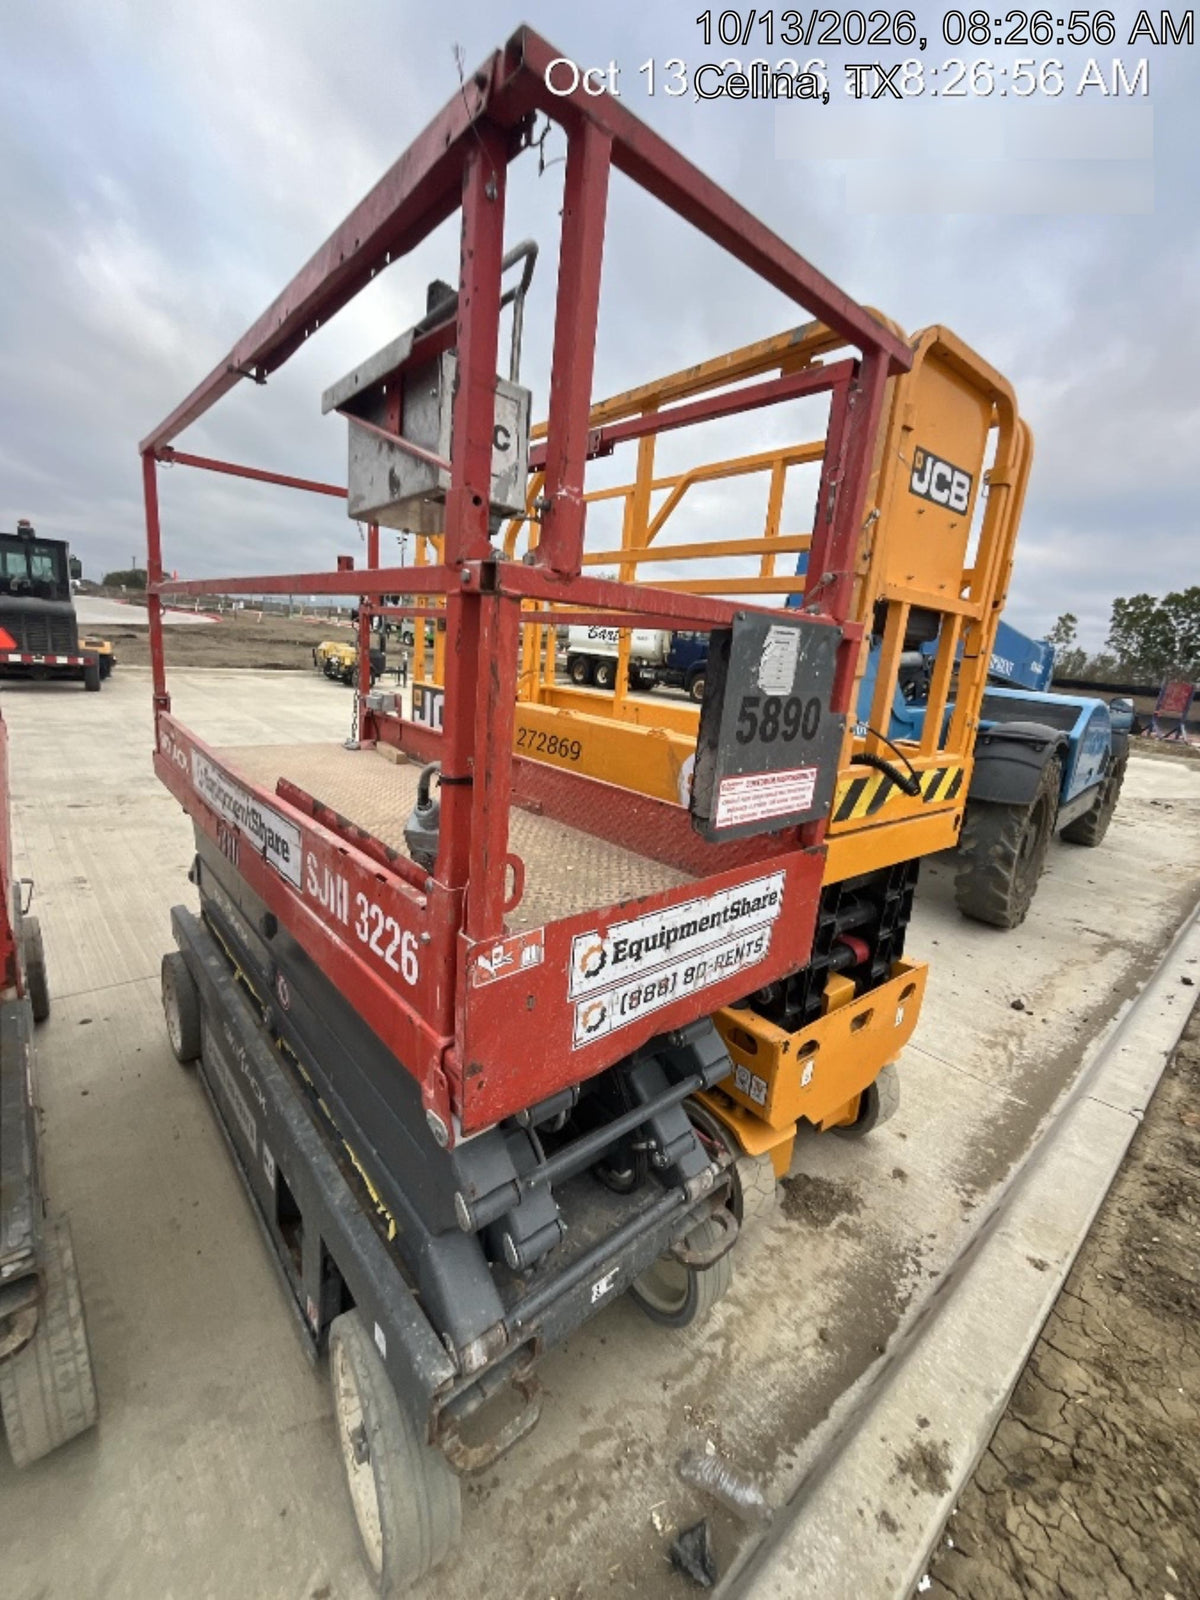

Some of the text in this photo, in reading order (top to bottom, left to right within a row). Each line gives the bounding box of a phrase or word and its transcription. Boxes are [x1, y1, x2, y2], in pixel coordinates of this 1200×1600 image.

[911, 456, 970, 512] JCB
[516, 726, 582, 761] 272869
[736, 696, 821, 744] 5890
[355, 892, 419, 986] 3226
[611, 890, 778, 966] EquipmentShare
[620, 972, 677, 1016] (888)
